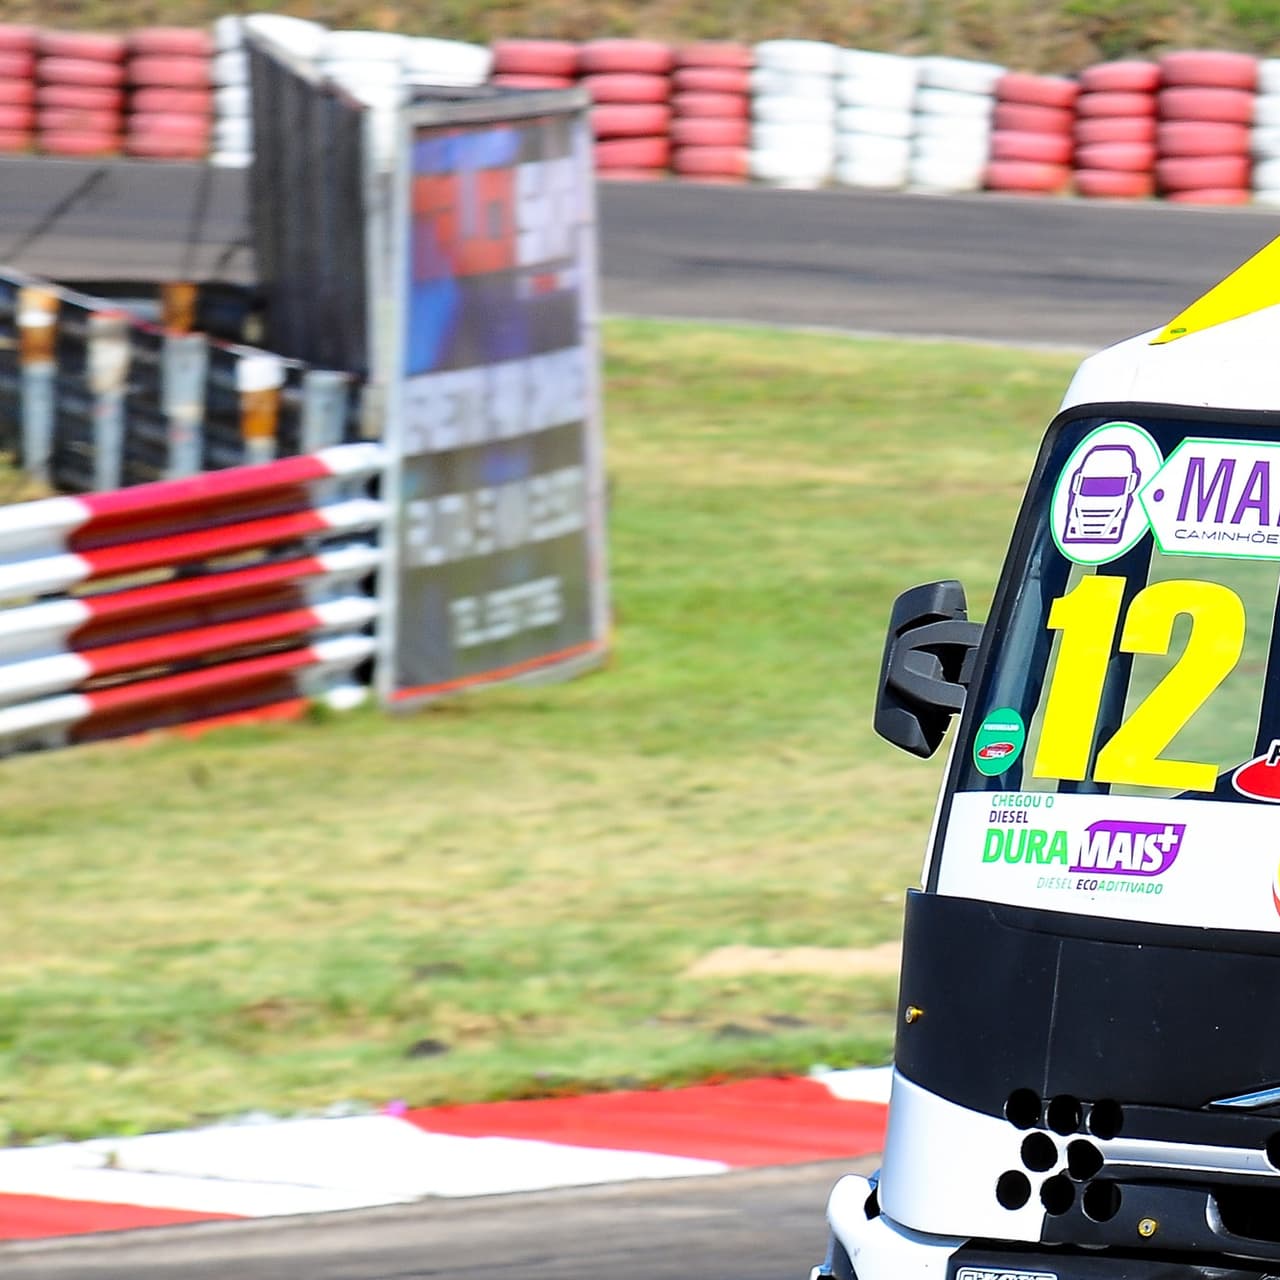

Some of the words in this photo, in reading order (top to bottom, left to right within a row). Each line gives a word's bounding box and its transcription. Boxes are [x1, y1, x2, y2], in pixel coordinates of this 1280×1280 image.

[1031, 575, 1246, 792] 12
[992, 794, 1041, 809] CHEGOU
[1045, 796, 1054, 808] O
[989, 810, 1029, 824] DIESEL
[982, 828, 1069, 865] DURA
[1037, 877, 1073, 890] DIESEL
[1076, 879, 1163, 895] ECOADITIVADO
